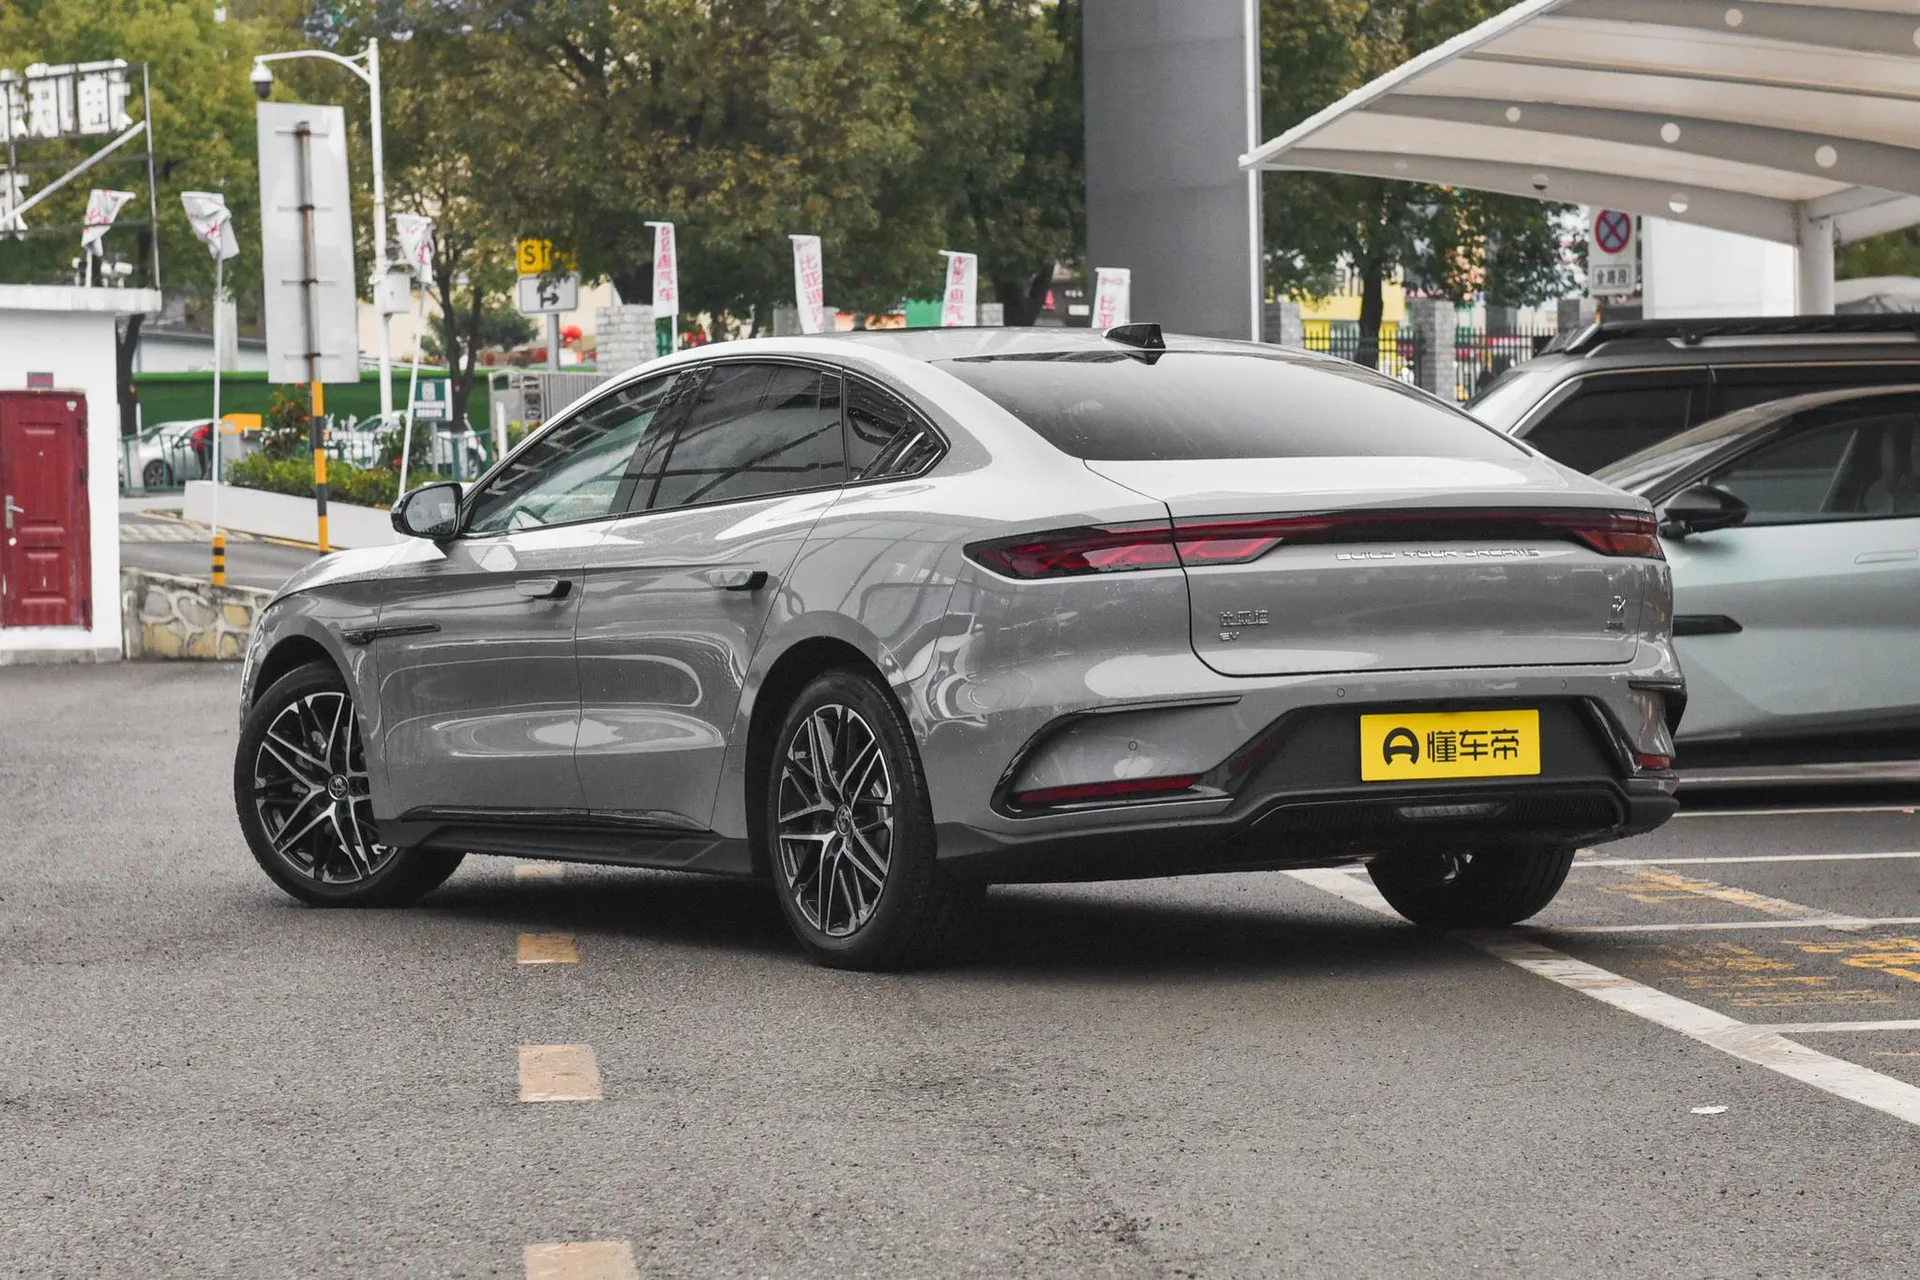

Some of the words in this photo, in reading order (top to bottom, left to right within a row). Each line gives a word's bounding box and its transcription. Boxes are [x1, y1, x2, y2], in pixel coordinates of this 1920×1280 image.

[1335, 551, 1397, 561] BUILD
[1402, 549, 1459, 560] YOUR
[1219, 631, 1240, 641] EV
[1427, 728, 1519, 763] 懂车帝
